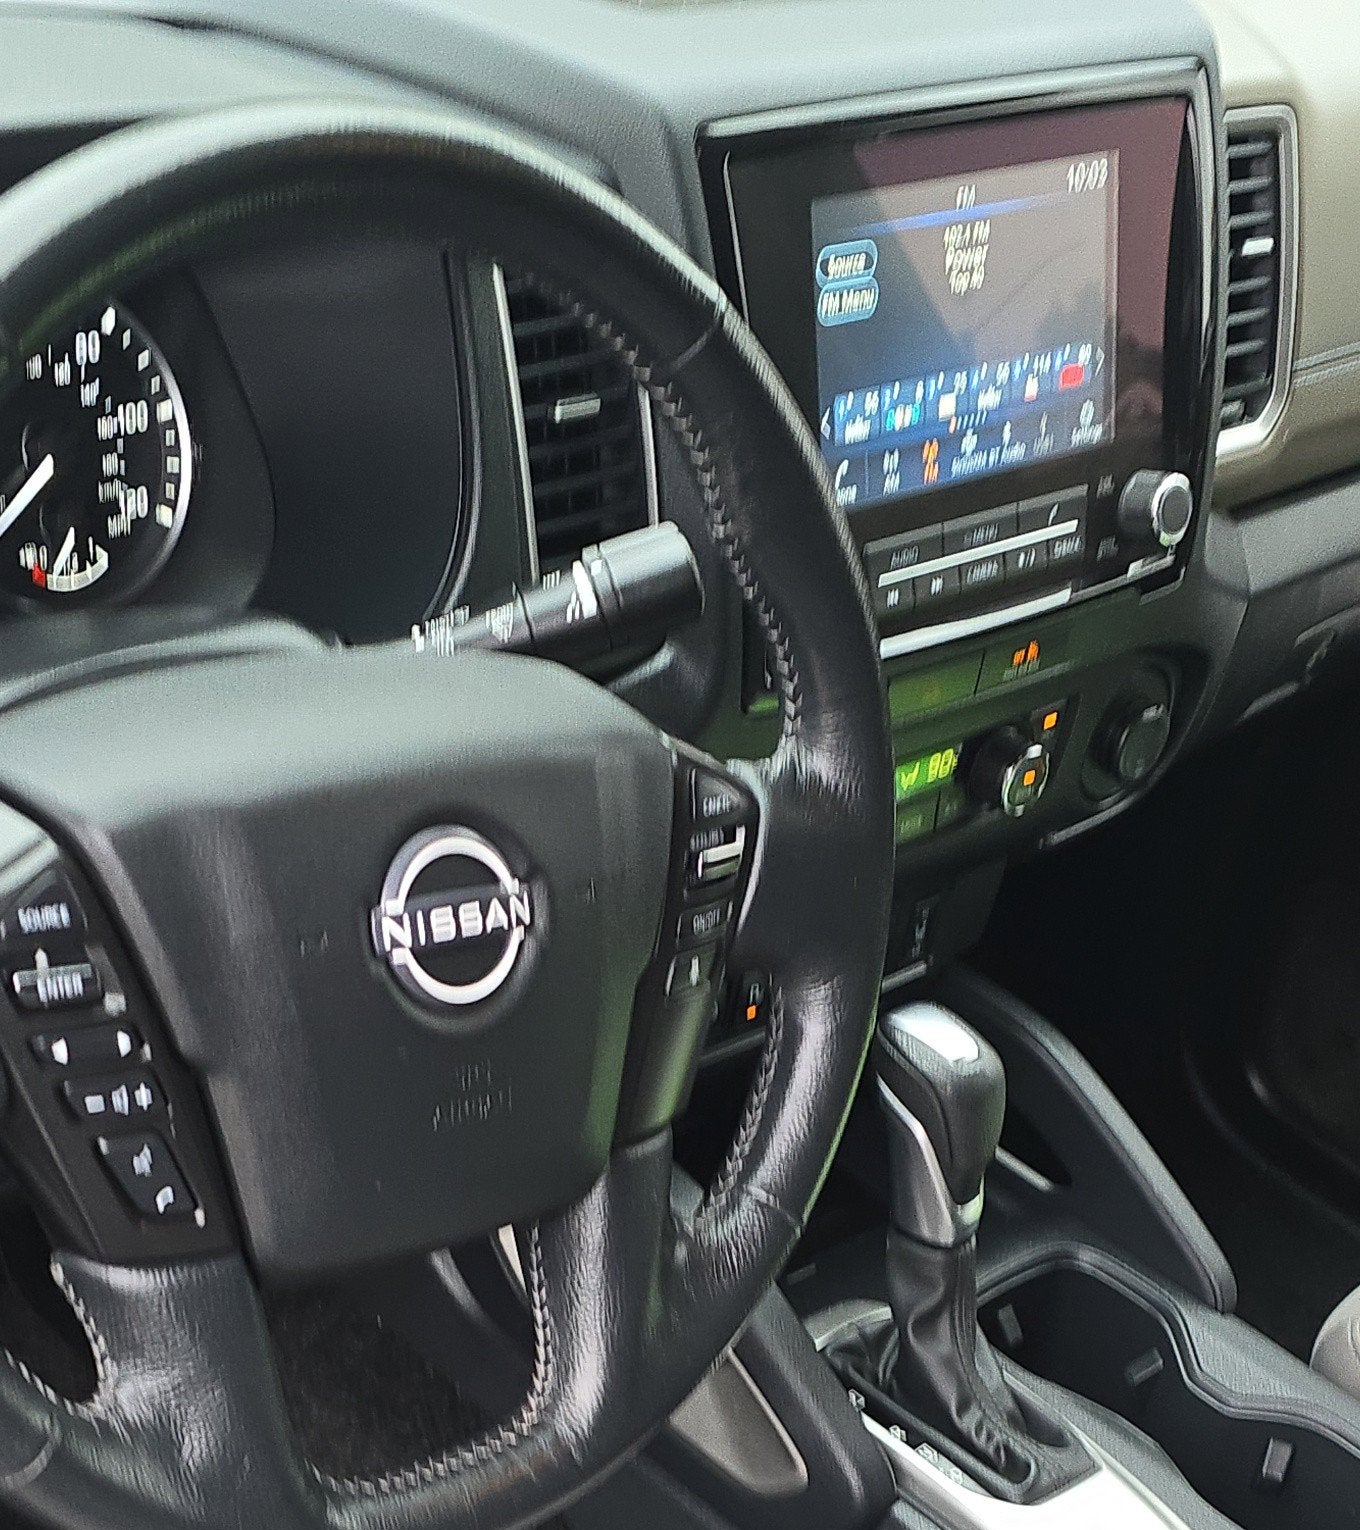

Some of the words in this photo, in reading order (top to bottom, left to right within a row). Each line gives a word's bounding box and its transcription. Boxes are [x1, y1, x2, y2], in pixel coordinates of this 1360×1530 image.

[956, 184, 976, 210] FM
[75, 330, 100, 365] 80
[117, 400, 149, 436] 100
[119, 486, 149, 521] 120
[381, 890, 530, 952] NISSAN
